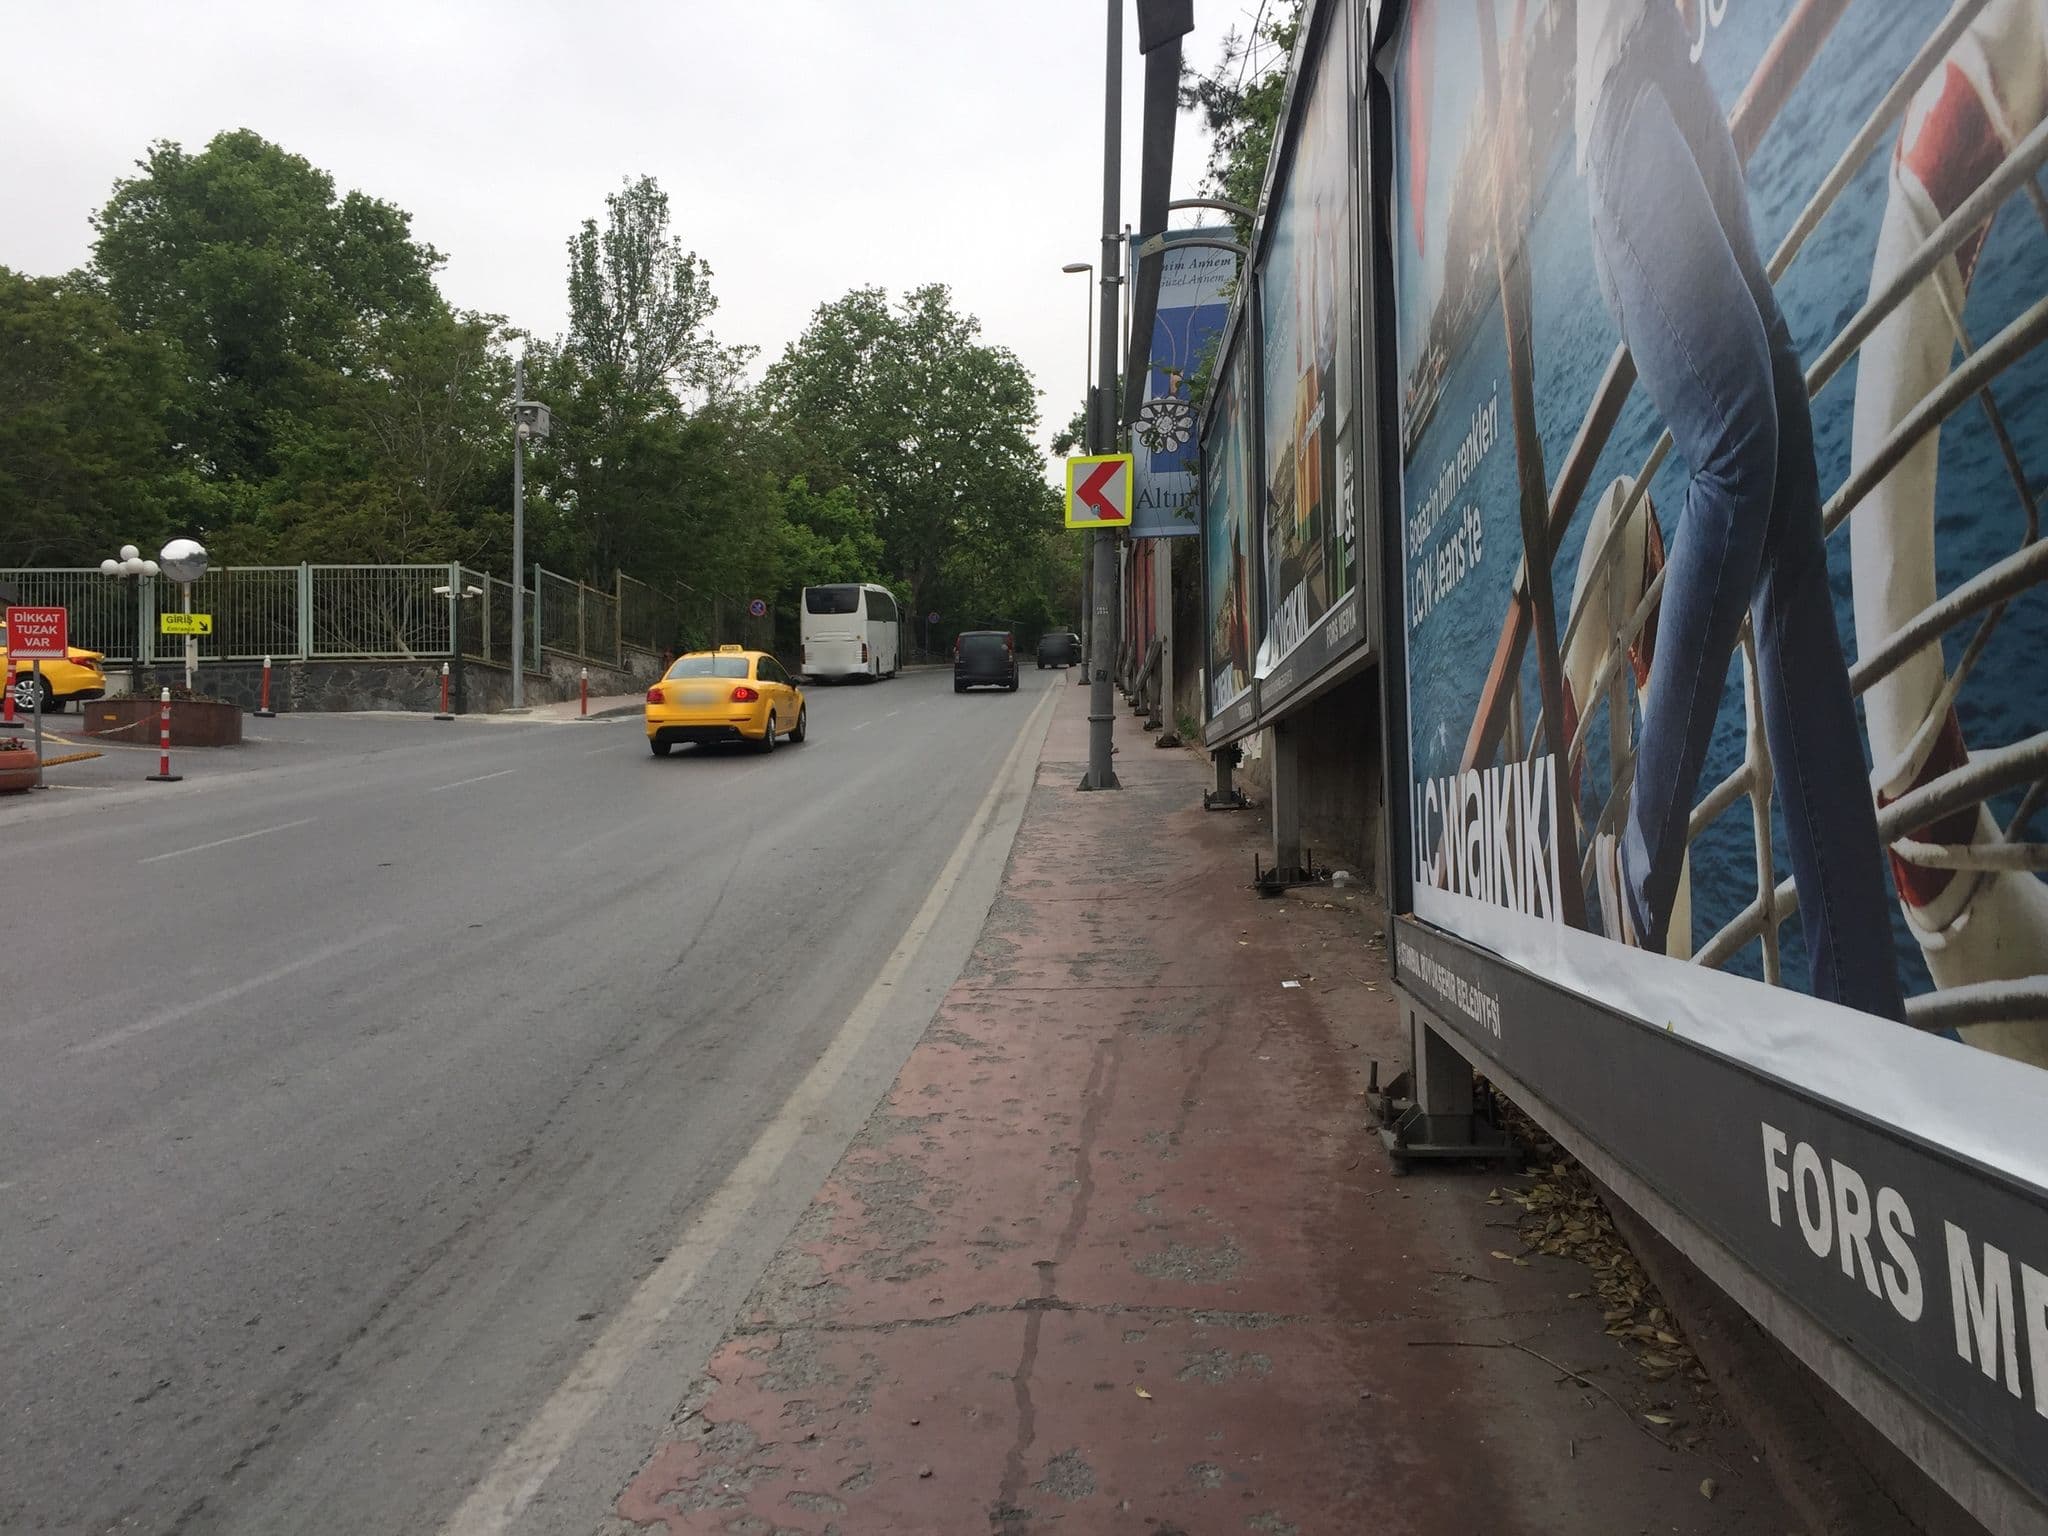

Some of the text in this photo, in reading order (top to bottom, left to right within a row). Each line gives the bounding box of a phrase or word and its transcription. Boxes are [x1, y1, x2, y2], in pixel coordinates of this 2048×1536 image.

[1439, 460, 1456, 517] tüm
[1457, 379, 1499, 490] renkleri
[1411, 552, 1432, 629] LCW
[1434, 503, 1483, 604] Jeans'te
[14, 611, 60, 623] DİKKAT
[166, 614, 193, 626] GİRİŞ
[16, 624, 58, 635] TUZAK
[24, 637, 50, 647] VAR
[1761, 1121, 1924, 1323] FORS
